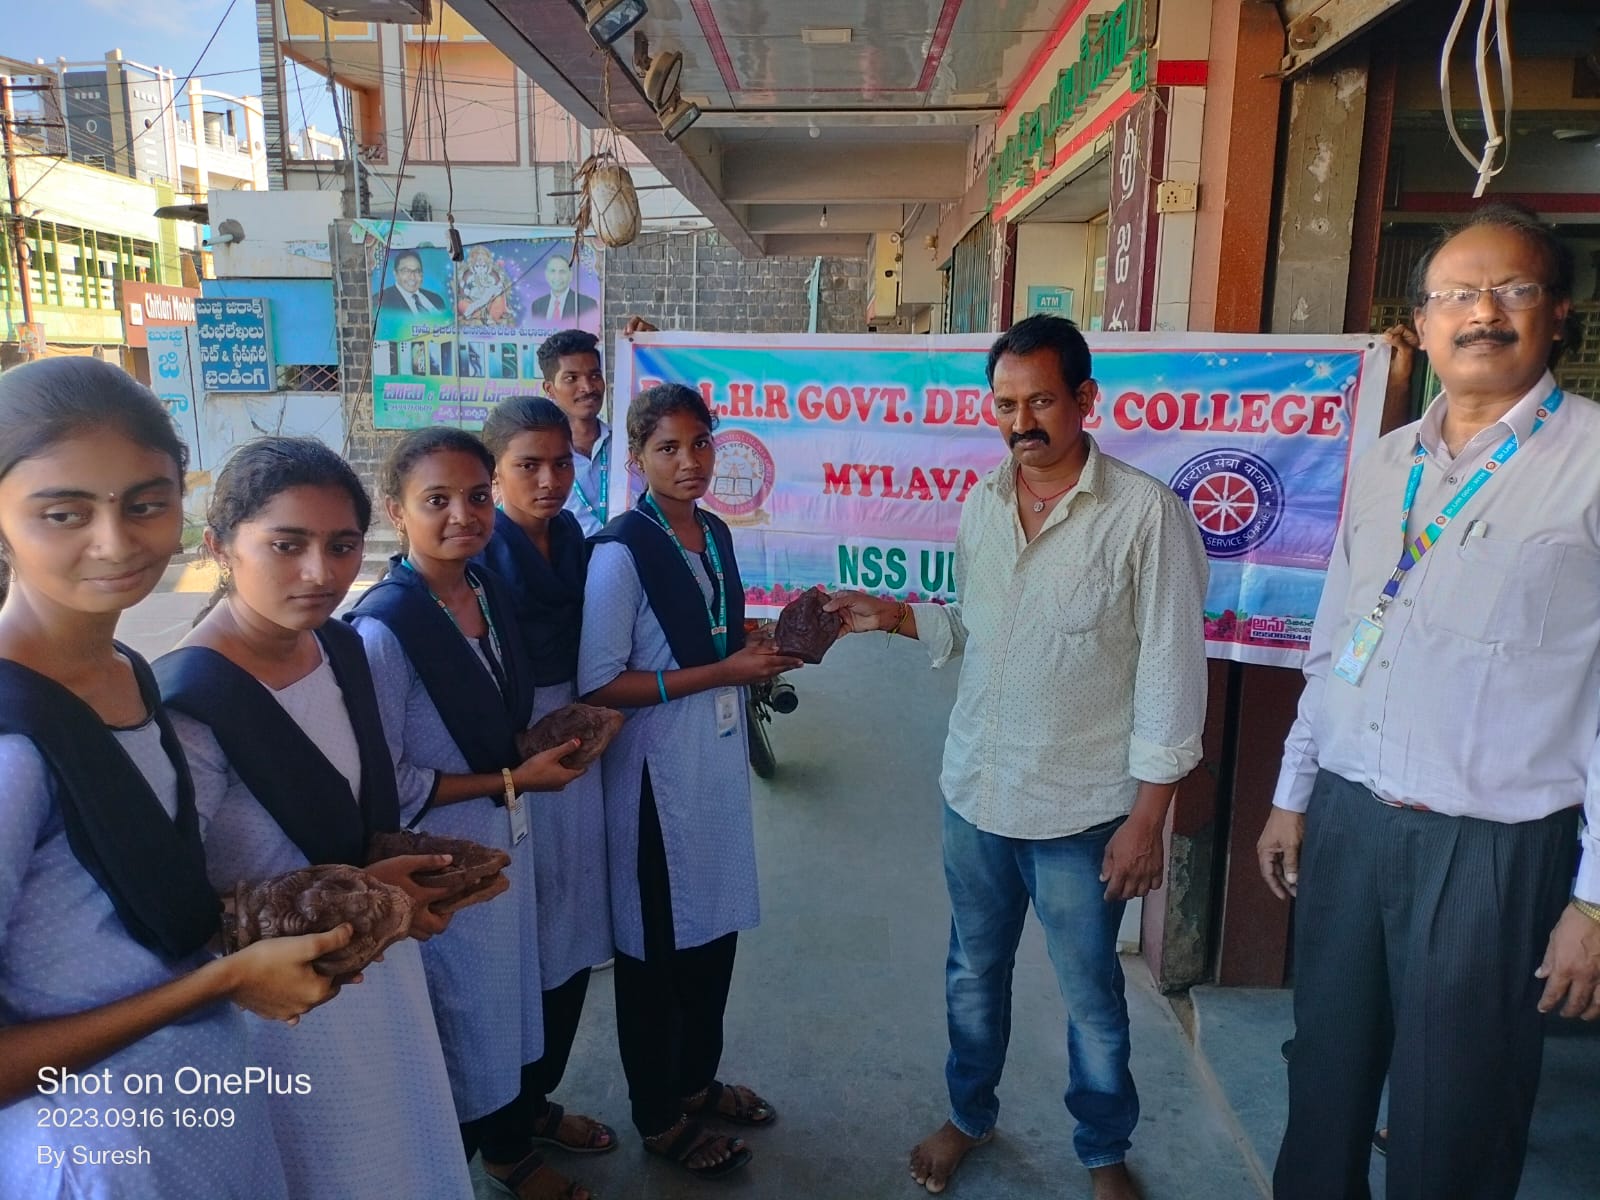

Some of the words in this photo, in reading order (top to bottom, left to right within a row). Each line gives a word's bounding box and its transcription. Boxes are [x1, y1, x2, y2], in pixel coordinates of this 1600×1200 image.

[1039, 296, 1059, 306] ATM
[222, 350, 231, 362] &
[798, 385, 913, 424] GOVT.
[1113, 392, 1342, 436] COLLEGE
[822, 463, 980, 502] MYLAVA
[1214, 455, 1240, 470] सेवा
[1244, 463, 1272, 493] योजना
[1207, 537, 1241, 547] SERVICE
[1243, 512, 1271, 542] SCHEME
[838, 545, 907, 589] NSS
